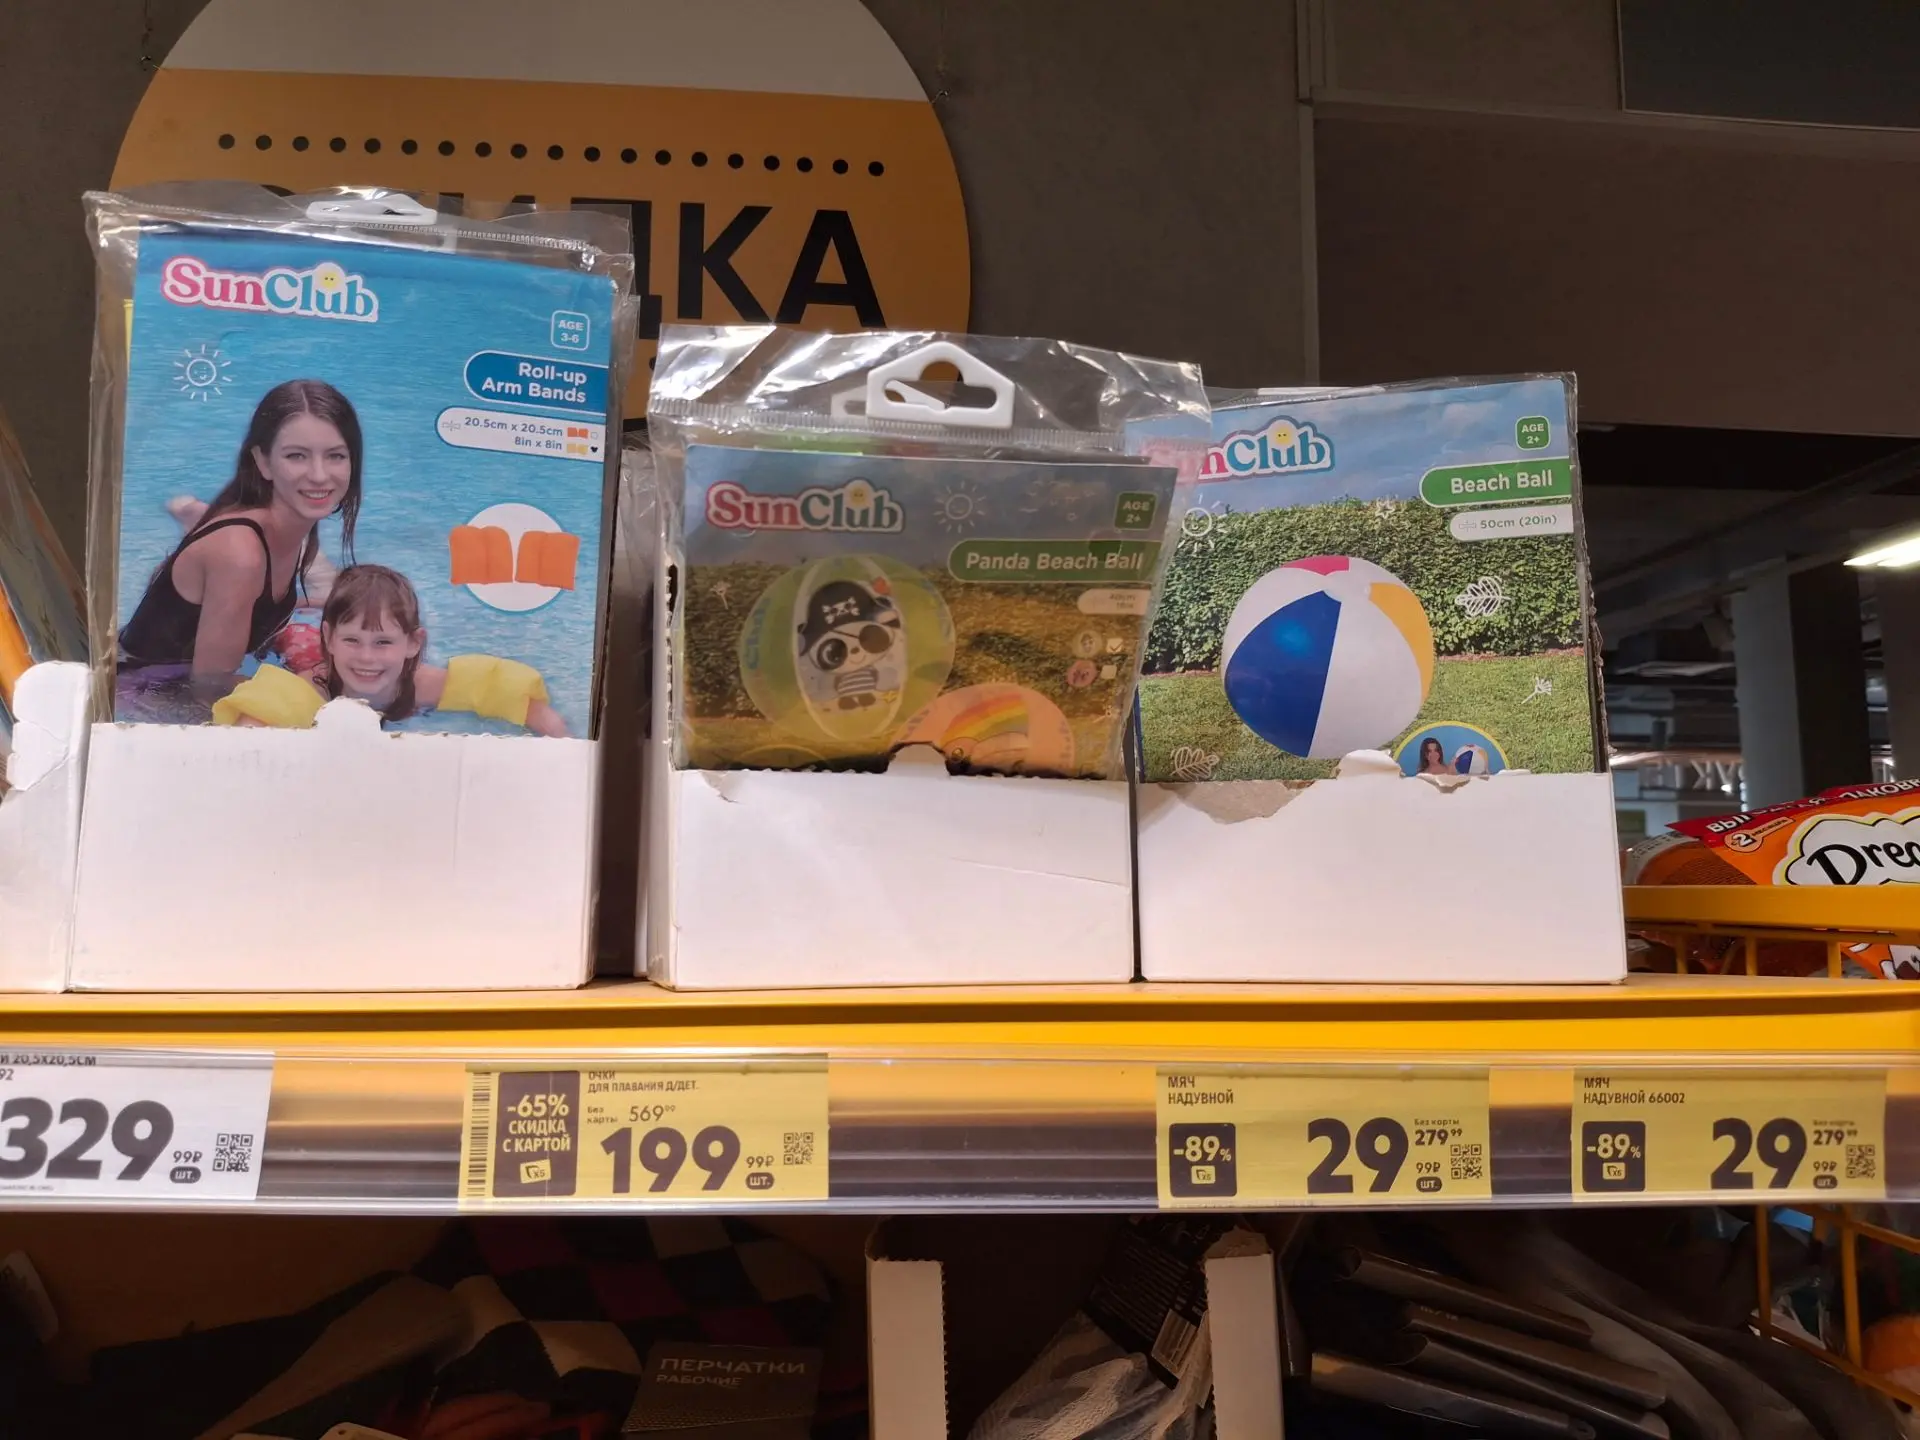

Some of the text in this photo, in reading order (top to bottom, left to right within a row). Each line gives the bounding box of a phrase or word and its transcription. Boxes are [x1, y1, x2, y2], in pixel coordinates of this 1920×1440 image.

[166, 261, 373, 319] SunClub
[558, 319, 584, 332] AGE
[560, 333, 580, 344] 3-6
[518, 362, 587, 387] Roll-up
[481, 377, 587, 404] Arm Bands
[465, 416, 564, 437] 20.5cm x 20.5cm
[1521, 422, 1544, 434] AGE
[514, 436, 532, 447] 8in
[545, 438, 563, 450] 8in
[1527, 435, 1540, 445] 2+
[1451, 470, 1553, 494] Beach Ball
[709, 483, 900, 529] SunClub
[1123, 501, 1150, 512] AGE
[1480, 513, 1558, 530] 50cm (20in)
[966, 552, 1144, 571] Panda Beach Ball
[1736, 832, 1752, 847] 2
[588, 1071, 616, 1081] ОЧКИ
[1168, 1076, 1196, 1088] МЯЧ
[1584, 1077, 1610, 1088] МЯЧ
[588, 1080, 699, 1094] ДЛЯ ПЛАВАНИЯ Д/ДЕТ.
[1168, 1089, 1234, 1106] НАДУВНОЙ
[1584, 1089, 1686, 1105] НАДУВНОЙ 66002
[507, 1094, 569, 1118] -65%
[628, 1105, 664, 1122] 569
[508, 1120, 567, 1137] СКИДКА
[0, 1097, 174, 1181] 329
[515, 1135, 571, 1152] КАРТОЙ
[1415, 1129, 1449, 1146] 279
[1813, 1129, 1845, 1146] 279
[1173, 1136, 1232, 1162] -89%
[1587, 1134, 1641, 1159] -89%
[1711, 1117, 1807, 1190] 29
[600, 1125, 741, 1194] 199
[1307, 1117, 1409, 1194] 29
[660, 1358, 806, 1375] ПЕРЧАТКИ
[656, 1374, 744, 1386] РАБОЧИЕ
